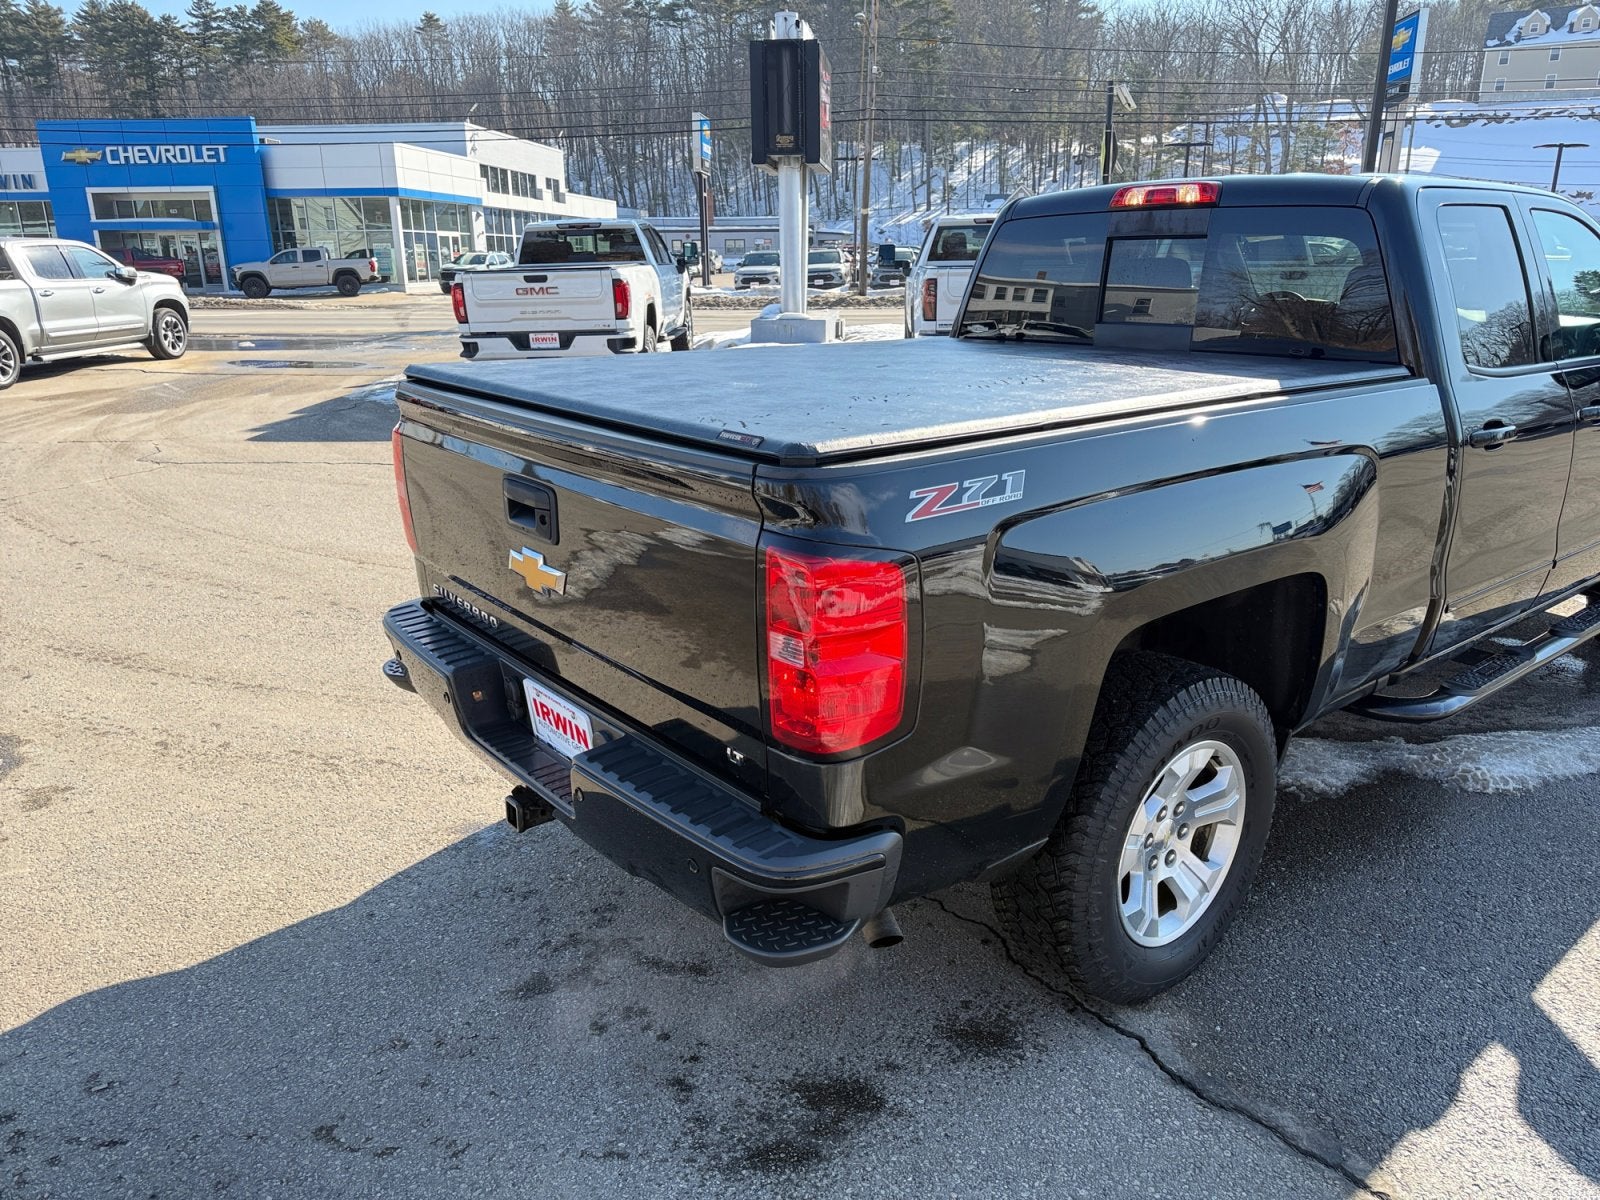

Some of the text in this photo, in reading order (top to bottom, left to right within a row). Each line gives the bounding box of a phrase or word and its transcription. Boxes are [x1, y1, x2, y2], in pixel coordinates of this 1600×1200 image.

[105, 145, 228, 164] CHEVROLET
[515, 286, 560, 296] GMC
[905, 469, 1026, 523] Z71
[981, 492, 1022, 506] OFF ROAD
[432, 583, 499, 629] SILVERADO
[532, 697, 590, 751] IRWIN
